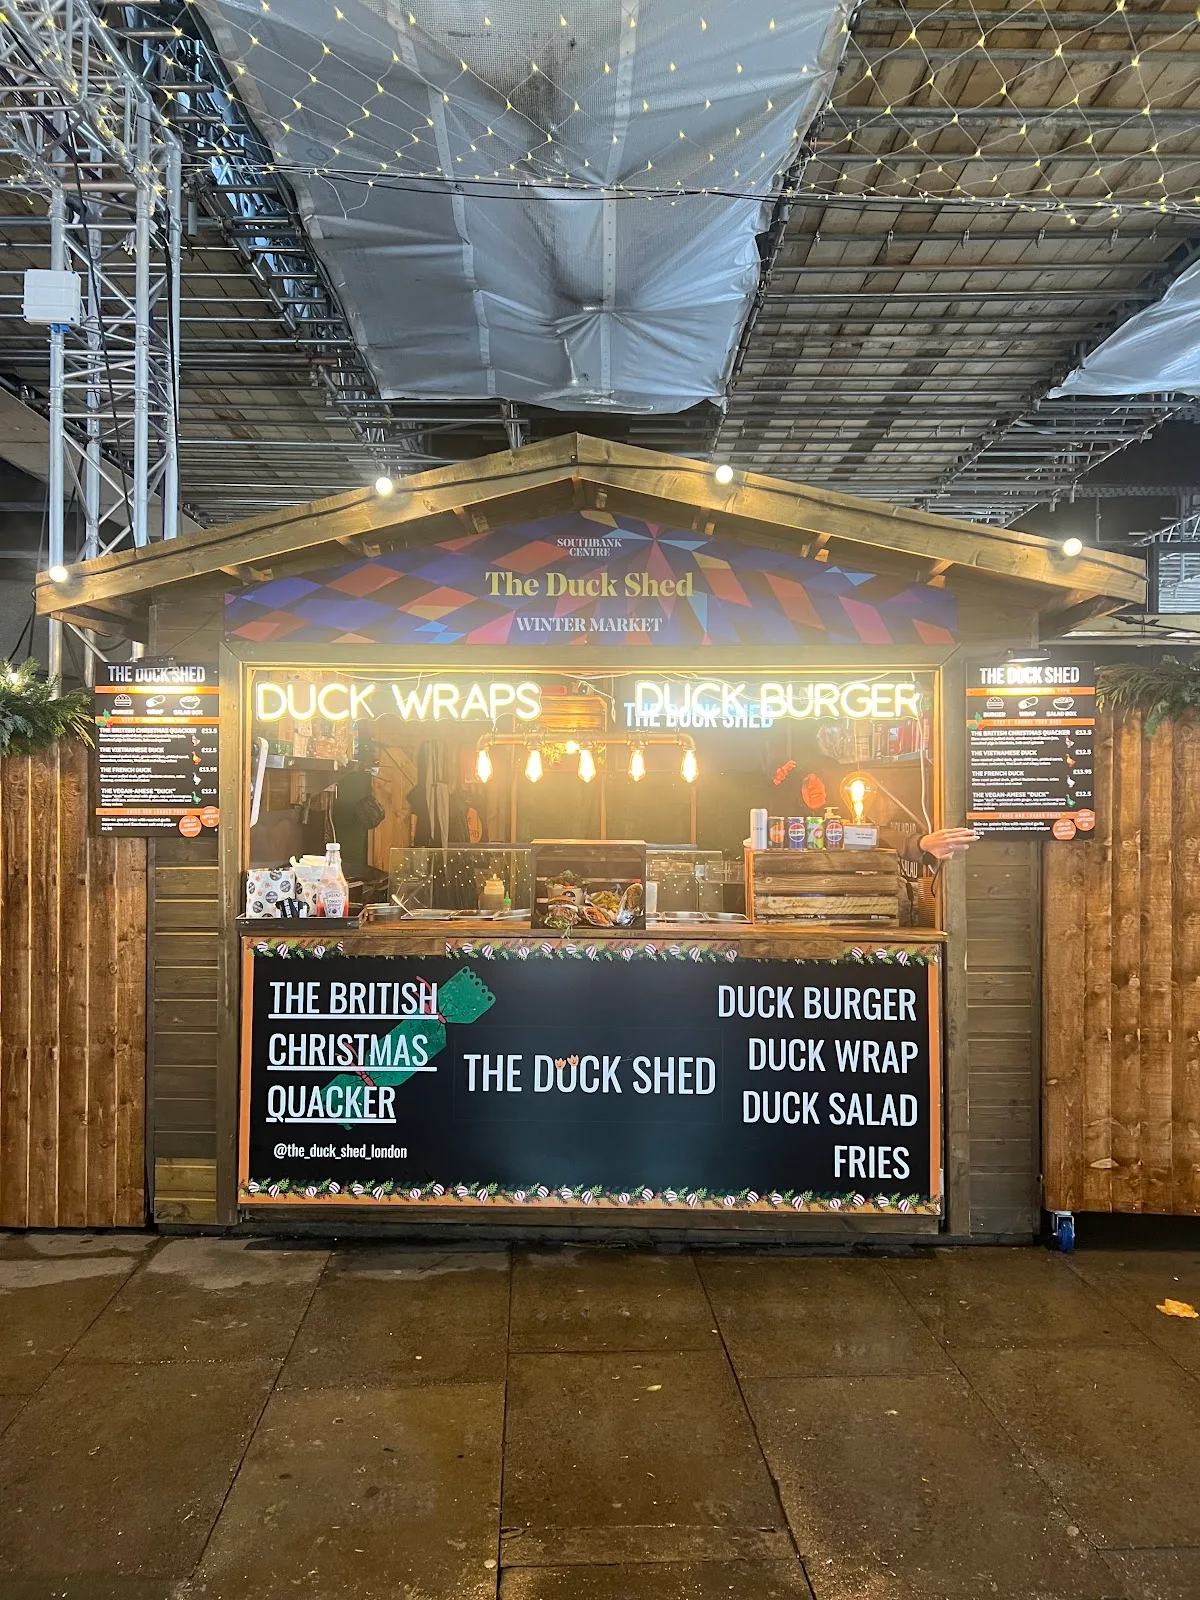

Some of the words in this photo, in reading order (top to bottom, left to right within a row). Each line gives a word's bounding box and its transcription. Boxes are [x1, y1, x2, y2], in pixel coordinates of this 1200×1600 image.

[557, 538, 622, 548] SOUTHBANK
[569, 548, 610, 557] CENTRE
[485, 572, 539, 597] The
[546, 572, 618, 597] Duck
[625, 572, 693, 597] Shed
[516, 617, 585, 632] WINTER
[590, 617, 662, 632] MARKET
[108, 666, 132, 682] THE
[135, 668, 169, 682] DUCK
[172, 667, 205, 682] SHED
[980, 667, 1005, 684] THE
[1006, 667, 1042, 684] DUCK
[1044, 667, 1080, 684] SHED
[257, 682, 375, 720] DUCK
[392, 682, 541, 720] WRAPS
[636, 682, 746, 719] DUCK
[760, 682, 920, 719] BURGER
[270, 982, 320, 1014] THE
[330, 982, 438, 1014] BRITISH
[718, 986, 795, 1019] DUCK
[804, 986, 917, 1022] BURGER
[269, 1033, 428, 1066] CHRISTMAS
[748, 1037, 826, 1072] DUCK
[834, 1039, 918, 1074] WRAP
[463, 1053, 522, 1092] THE
[534, 1054, 622, 1094] DUCK
[632, 1056, 716, 1095] SHED
[268, 1085, 396, 1122] QUACKER
[742, 1090, 820, 1124] DUCK
[828, 1092, 918, 1127] SALAD
[273, 1142, 408, 1160] @the_duck_shed_london
[834, 1144, 910, 1180] FRIES
